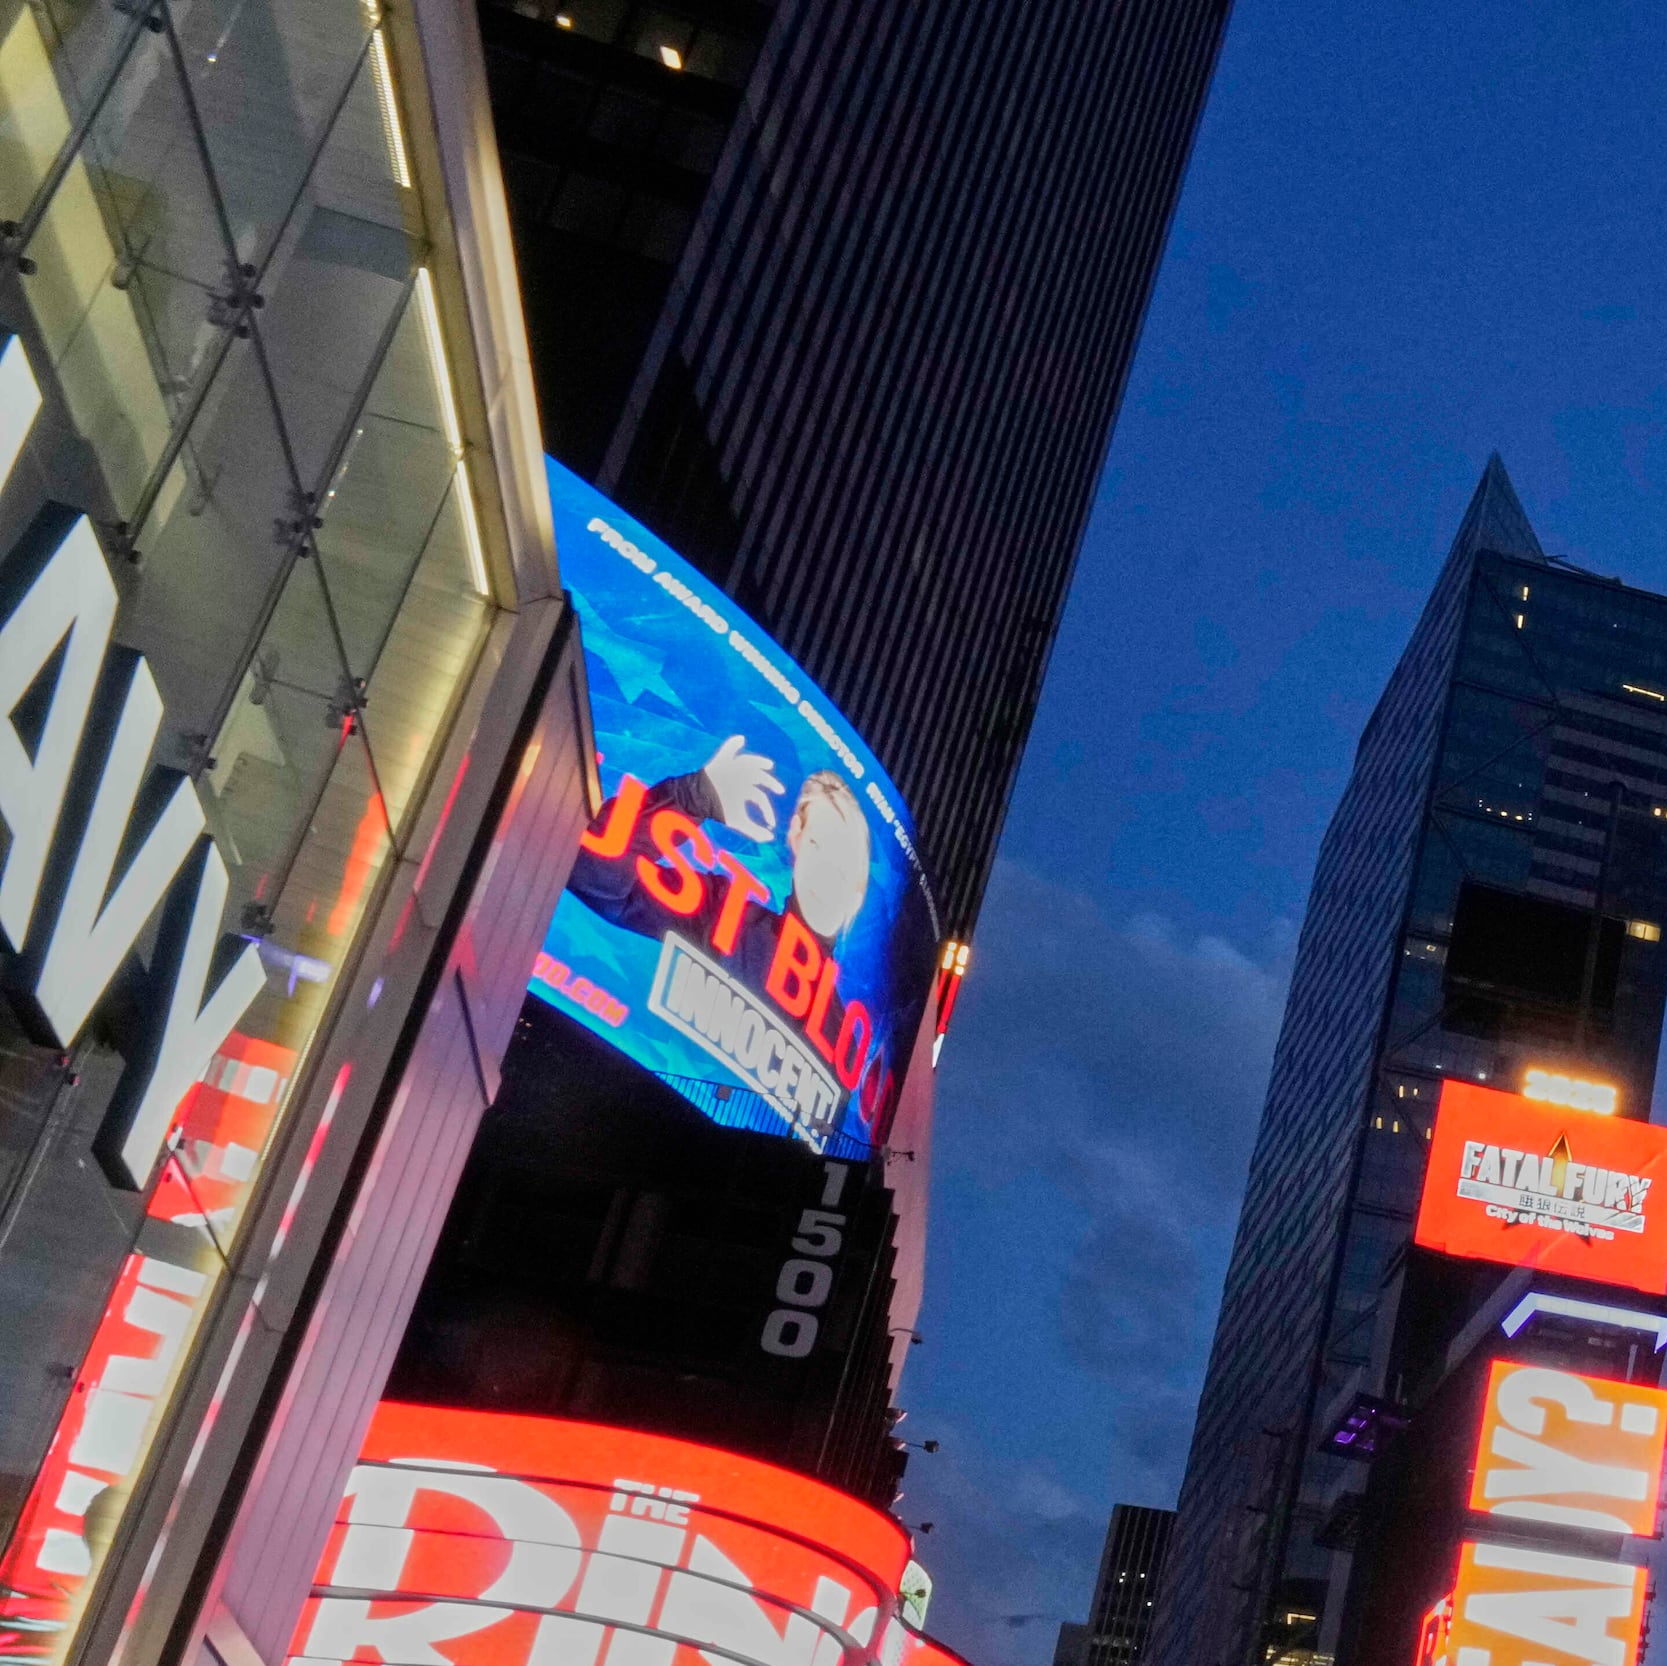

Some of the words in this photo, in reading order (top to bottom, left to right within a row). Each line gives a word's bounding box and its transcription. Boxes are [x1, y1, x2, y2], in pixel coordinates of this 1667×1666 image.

[587, 517, 657, 573] FROM
[0, 335, 267, 1192] AVY
[667, 952, 834, 1118] INNOCENT
[1460, 1140, 1558, 1197] FATAL
[1563, 1162, 1652, 1214] FURY
[760, 1161, 848, 1357] 1500
[1485, 1204, 1517, 1222] City
[1518, 1212, 1536, 1226] of
[1538, 1214, 1562, 1229] the
[1563, 1218, 1615, 1241] Wolves
[610, 1478, 702, 1525] THE
